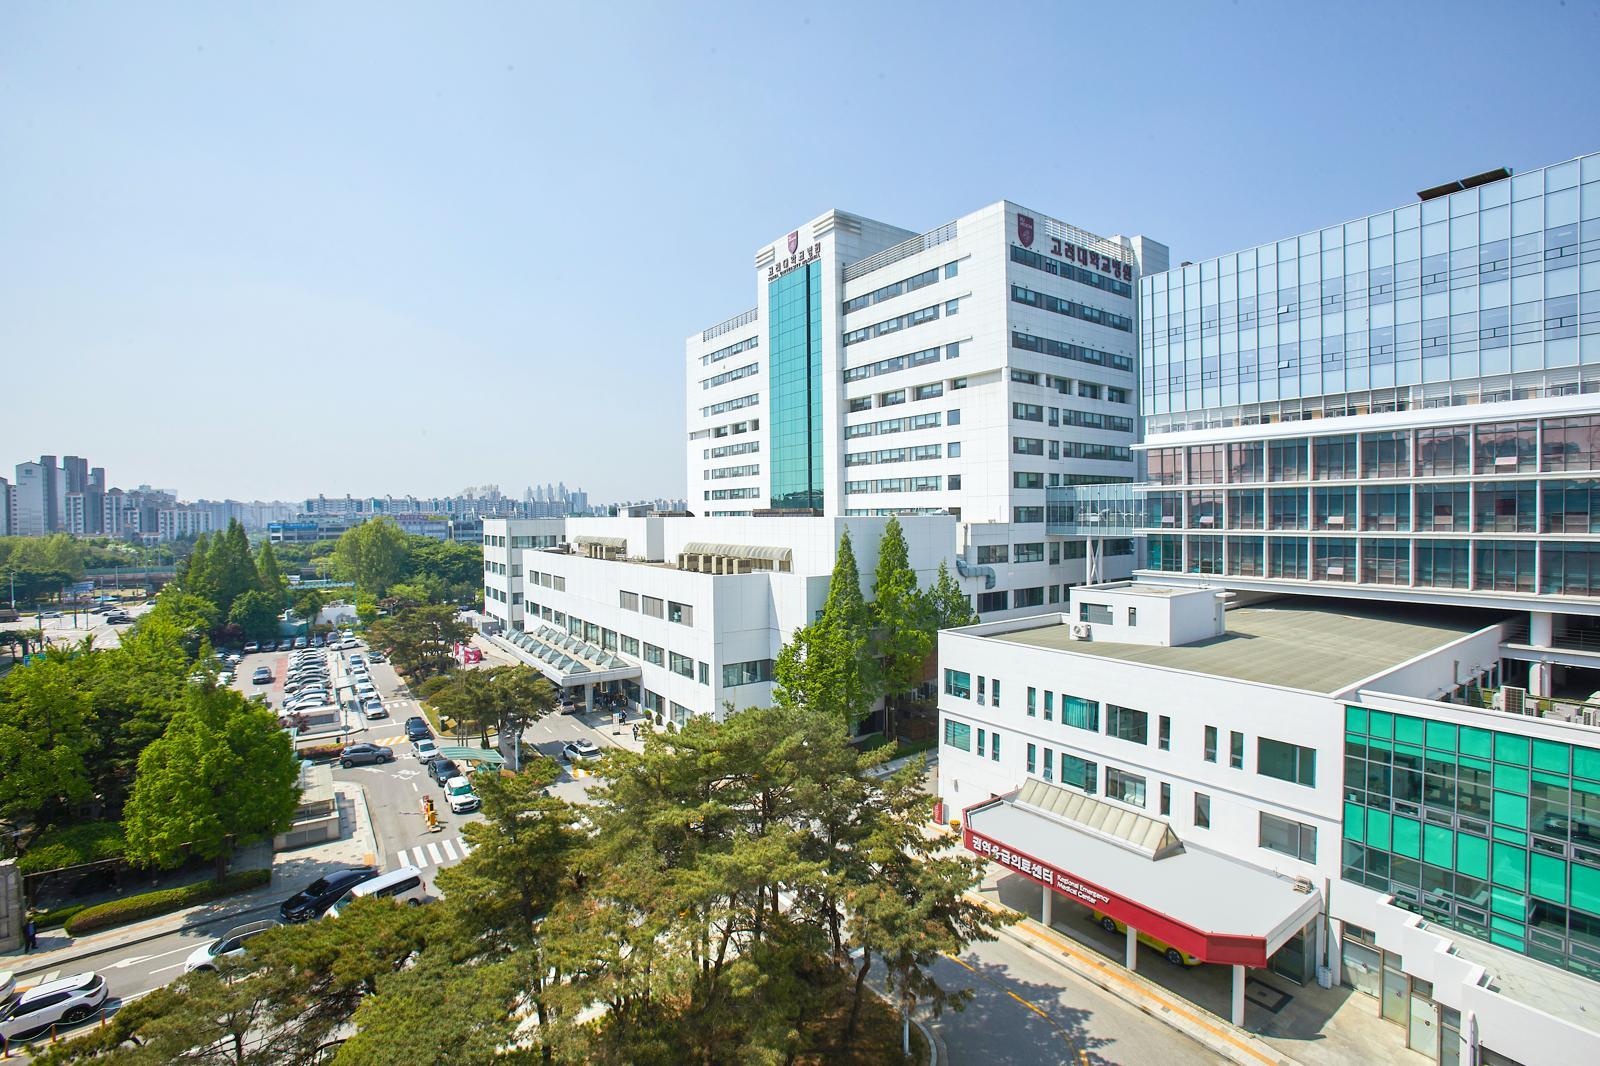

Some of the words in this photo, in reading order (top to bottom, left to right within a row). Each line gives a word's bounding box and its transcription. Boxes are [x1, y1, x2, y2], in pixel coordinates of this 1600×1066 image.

[768, 242, 821, 277] 고려대학교병원
[1051, 236, 1132, 281] 고려대학교병원
[972, 836, 1054, 885] 권역응급의료센터
[1057, 874, 1080, 890] Regional
[1079, 884, 1110, 903] Emergency
[1057, 881, 1078, 896] Medical
[1077, 891, 1097, 904] Center
